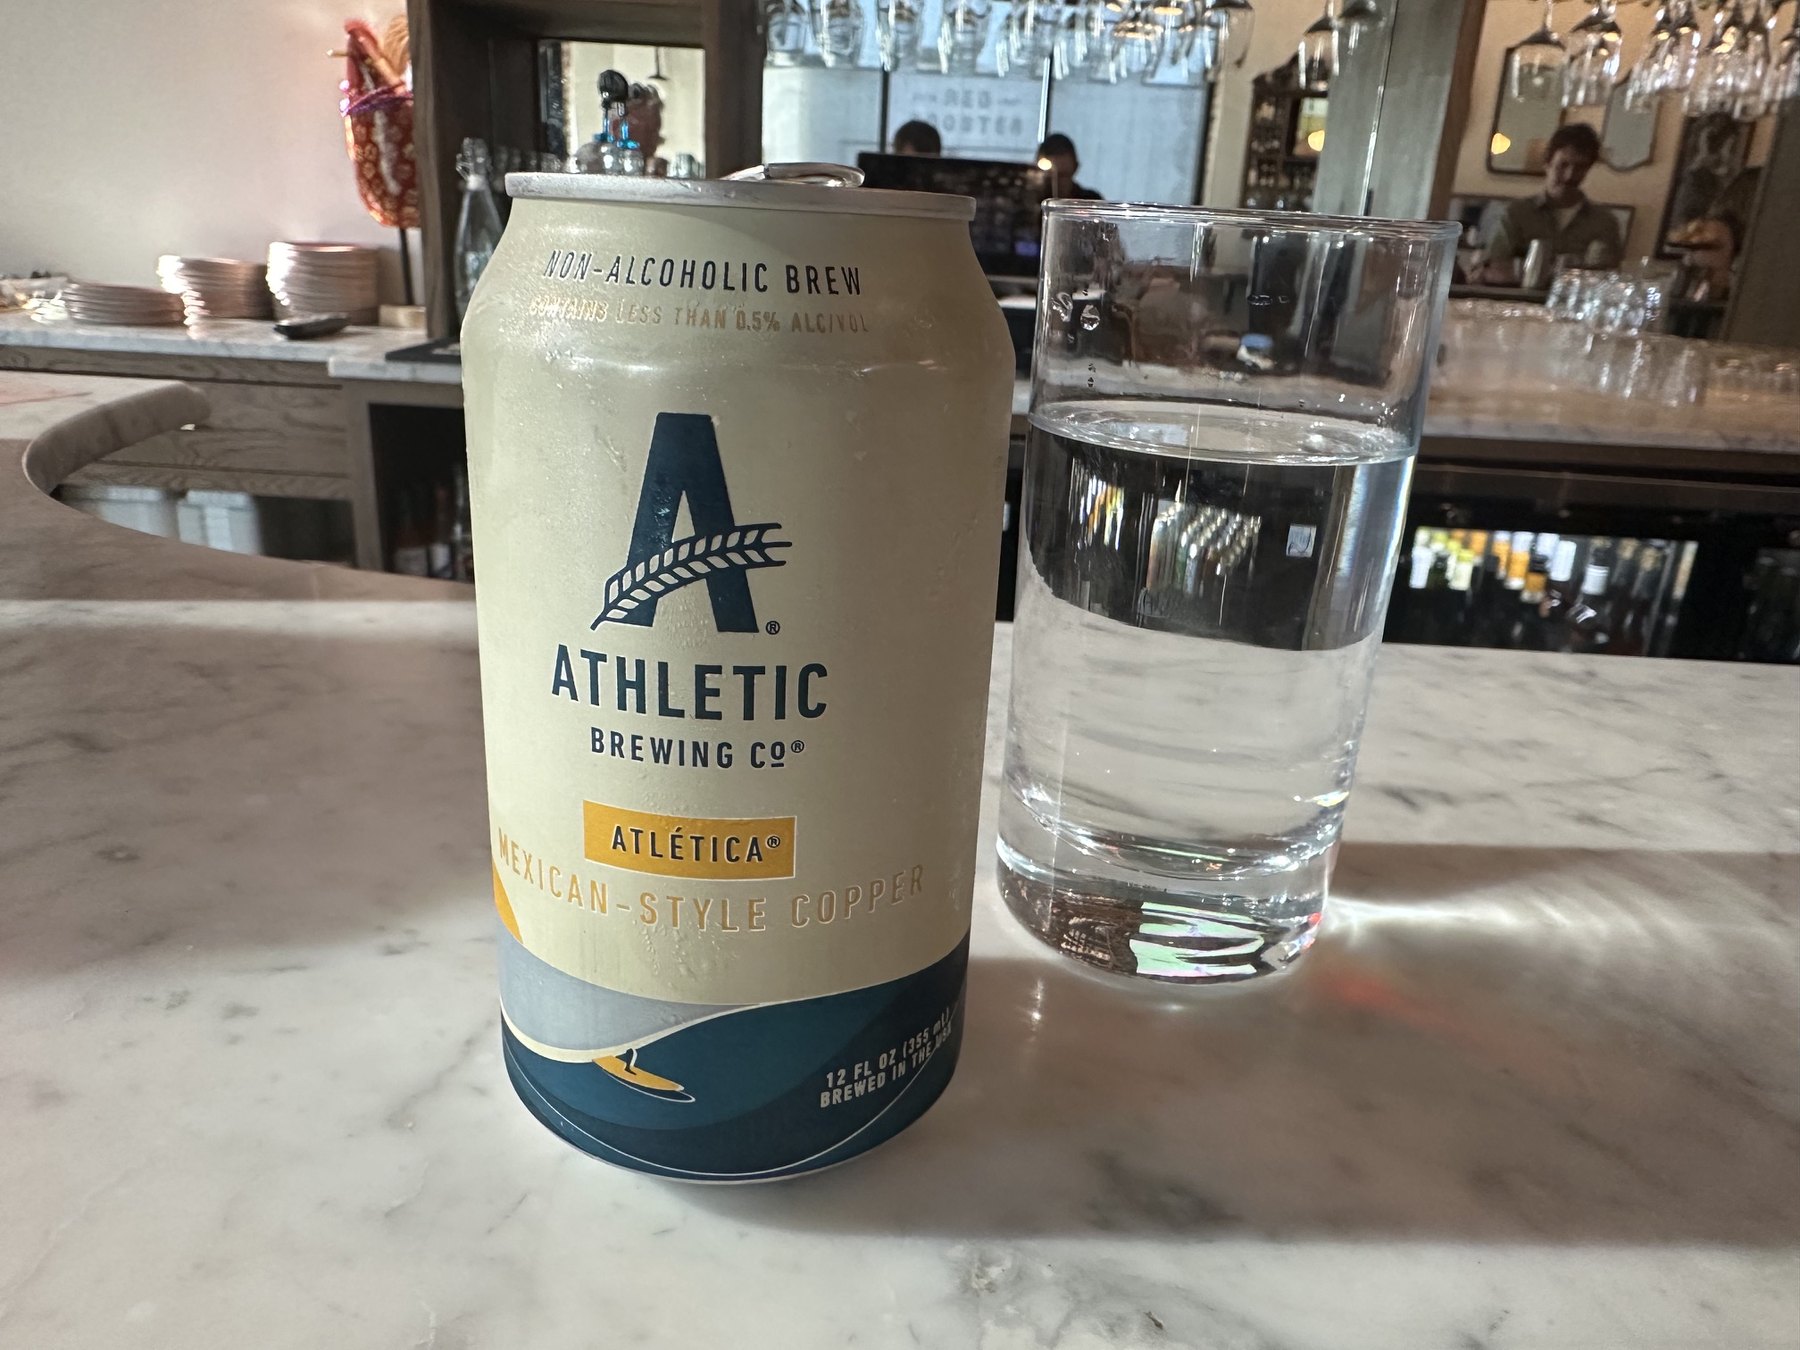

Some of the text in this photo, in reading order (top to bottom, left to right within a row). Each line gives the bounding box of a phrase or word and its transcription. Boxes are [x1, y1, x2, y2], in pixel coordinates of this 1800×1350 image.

[543, 249, 862, 296] NON-ALCOHOLIC BREW
[615, 300, 663, 325] LESS
[674, 306, 726, 330] THAN
[736, 309, 781, 332] 0.5%
[791, 311, 870, 333] ALC/VOL
[551, 643, 828, 721] ATHLETIC
[590, 726, 733, 769] BREWING
[498, 827, 925, 932] MEXICAN-STYLE COPPER
[820, 1072, 886, 1108] BREWED
[892, 1062, 906, 1081] IN
[912, 1041, 932, 1069] THE
[826, 1068, 846, 1088] 12
[854, 1060, 872, 1080] FL
[878, 1048, 896, 1070] OZ
[902, 1027, 929, 1058] (355
